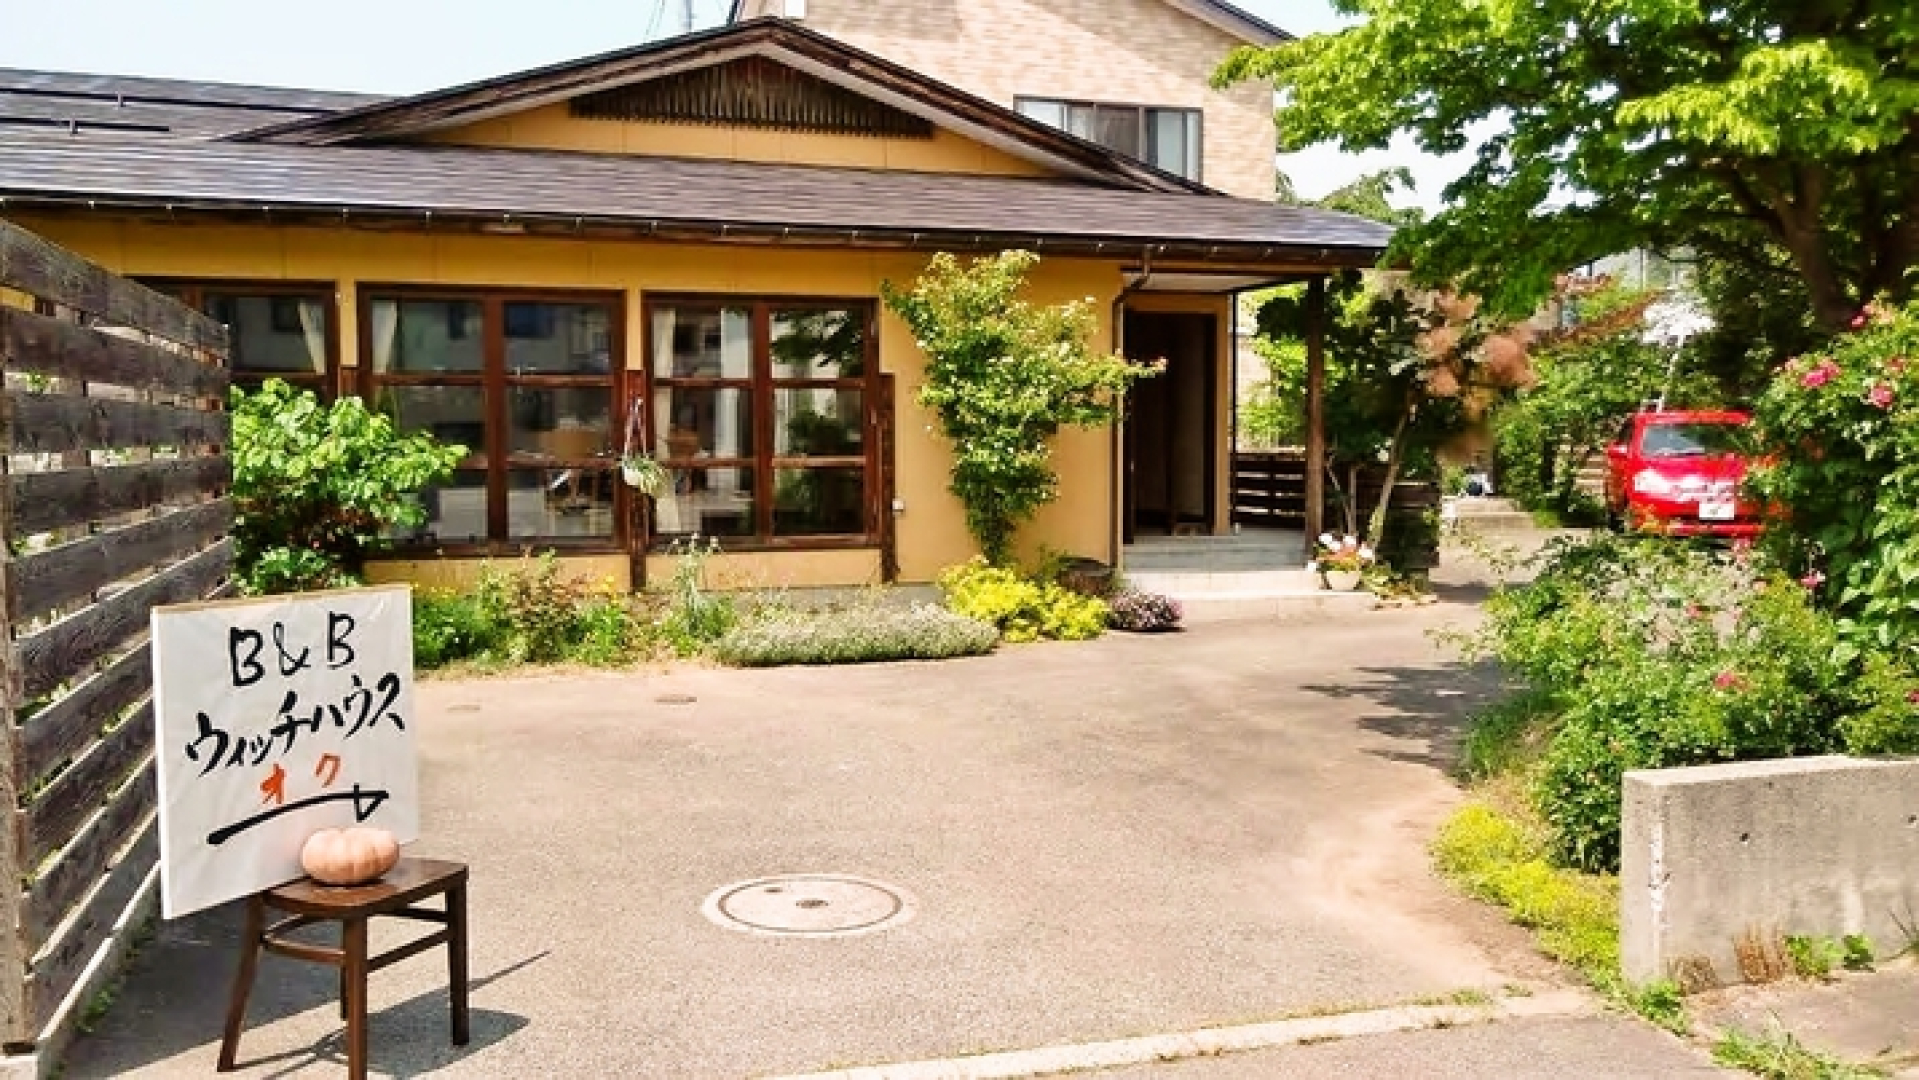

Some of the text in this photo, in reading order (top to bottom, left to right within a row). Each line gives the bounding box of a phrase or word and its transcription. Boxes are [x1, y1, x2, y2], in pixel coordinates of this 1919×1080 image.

[185, 672, 405, 778] ウィッチハウス
